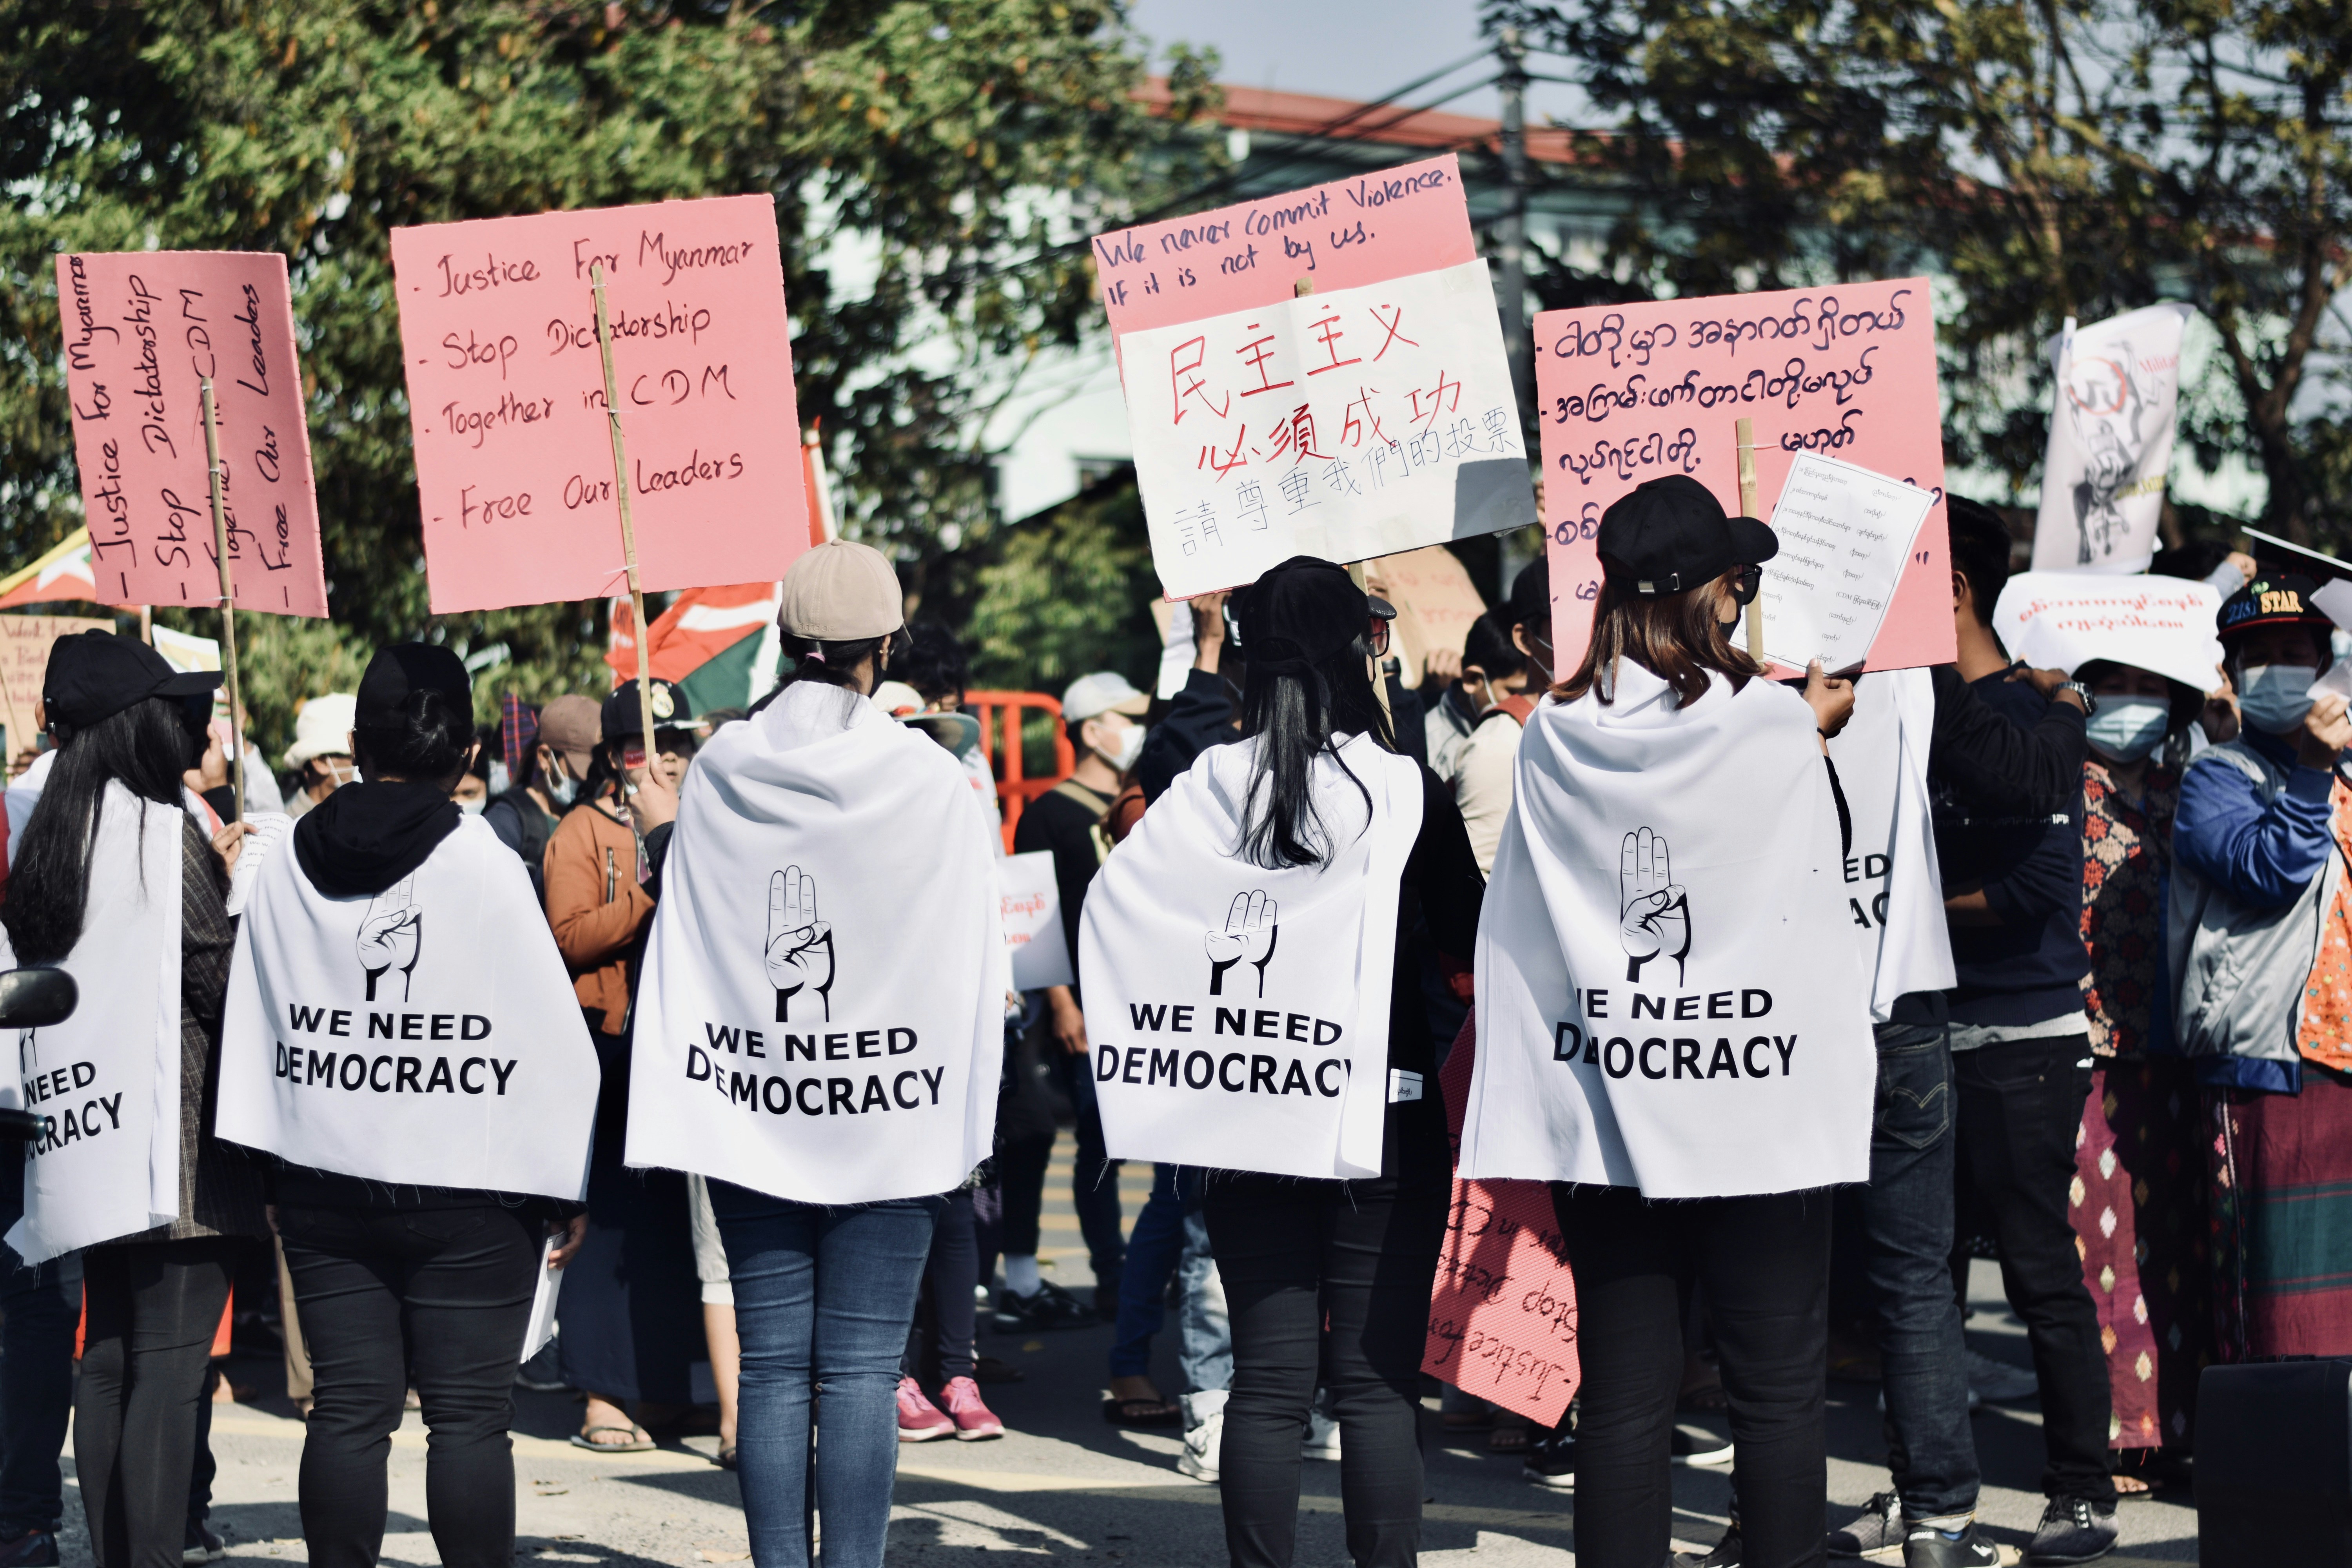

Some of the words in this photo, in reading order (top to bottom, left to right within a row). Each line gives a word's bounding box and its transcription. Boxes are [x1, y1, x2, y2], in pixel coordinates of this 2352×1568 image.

[437, 253, 540, 298] Justice
[574, 238, 620, 281] For
[639, 230, 754, 286] Myanmar
[1096, 230, 1147, 268] We
[1160, 221, 1230, 254] never
[1144, 272, 1160, 295] it
[1178, 268, 1196, 288] is
[1221, 244, 1259, 275] not
[1284, 235, 1315, 271] by
[69, 256, 120, 370] Myanmar
[179, 289, 215, 379] CDM
[234, 284, 269, 396] Leaders
[443, 332, 517, 379] Stop
[547, 300, 710, 356] Dictatorship
[123, 274, 177, 459] Dictatorship
[1171, 304, 1419, 426] 民主主义
[73, 381, 111, 421] For
[442, 391, 554, 449] Together
[583, 389, 609, 410] in
[631, 364, 736, 405] CDM
[1198, 370, 1461, 483] 必須成功
[255, 425, 280, 483] Our
[1174, 407, 1519, 557] 請尊重我們的投票
[90, 438, 136, 568] Justice
[462, 485, 532, 529] Free
[564, 475, 611, 510] Our
[637, 449, 743, 495] Leaders
[154, 488, 201, 568] Stop
[258, 503, 292, 571] Free
[798, 623, 835, 632] adidas
[2260, 590, 2304, 614] STAR
[1843, 853, 1891, 883] ED
[289, 1003, 352, 1037] WE
[368, 1013, 492, 1040] NEED
[1129, 1003, 1194, 1032] WE
[1215, 1007, 1342, 1045] NEED
[1577, 988, 1608, 1018] E
[1631, 989, 1772, 1020] NEED
[276, 1040, 518, 1095] DEMOCRACY
[705, 1022, 766, 1058] WE
[785, 1027, 918, 1061] NEED
[1096, 1044, 1352, 1098] DEMOCRAC
[1553, 1022, 1797, 1080] DOCRACY
[25, 1061, 96, 1108] NEED
[686, 1044, 945, 1116] DEMOCRACY
[1522, 1280, 1577, 1343] Stop
[1468, 1330, 1564, 1402] Justice
